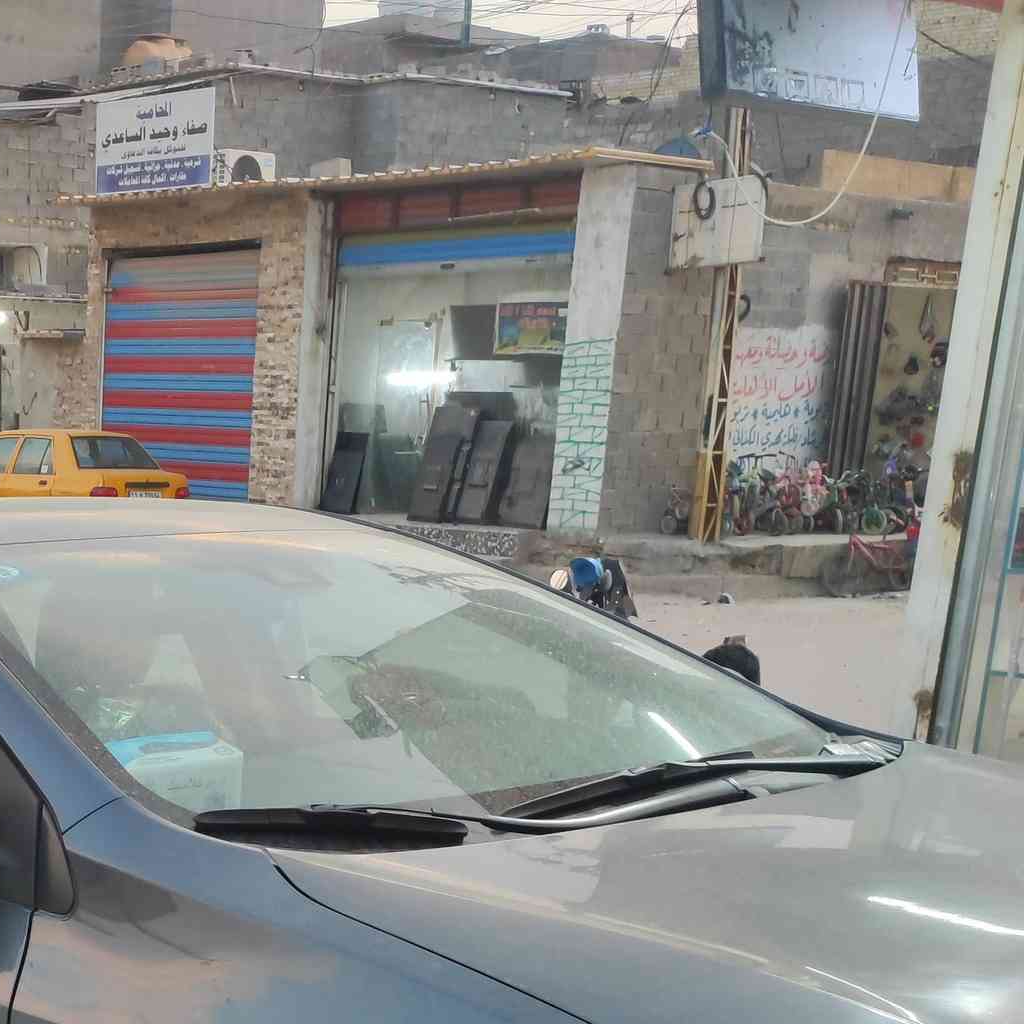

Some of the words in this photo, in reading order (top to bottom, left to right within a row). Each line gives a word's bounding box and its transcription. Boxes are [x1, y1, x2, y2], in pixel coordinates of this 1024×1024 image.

[136, 102, 172, 123] المحامية
[149, 125, 178, 142] وحيد
[182, 119, 208, 136] صفاء
[101, 127, 146, 152] الساعدي
